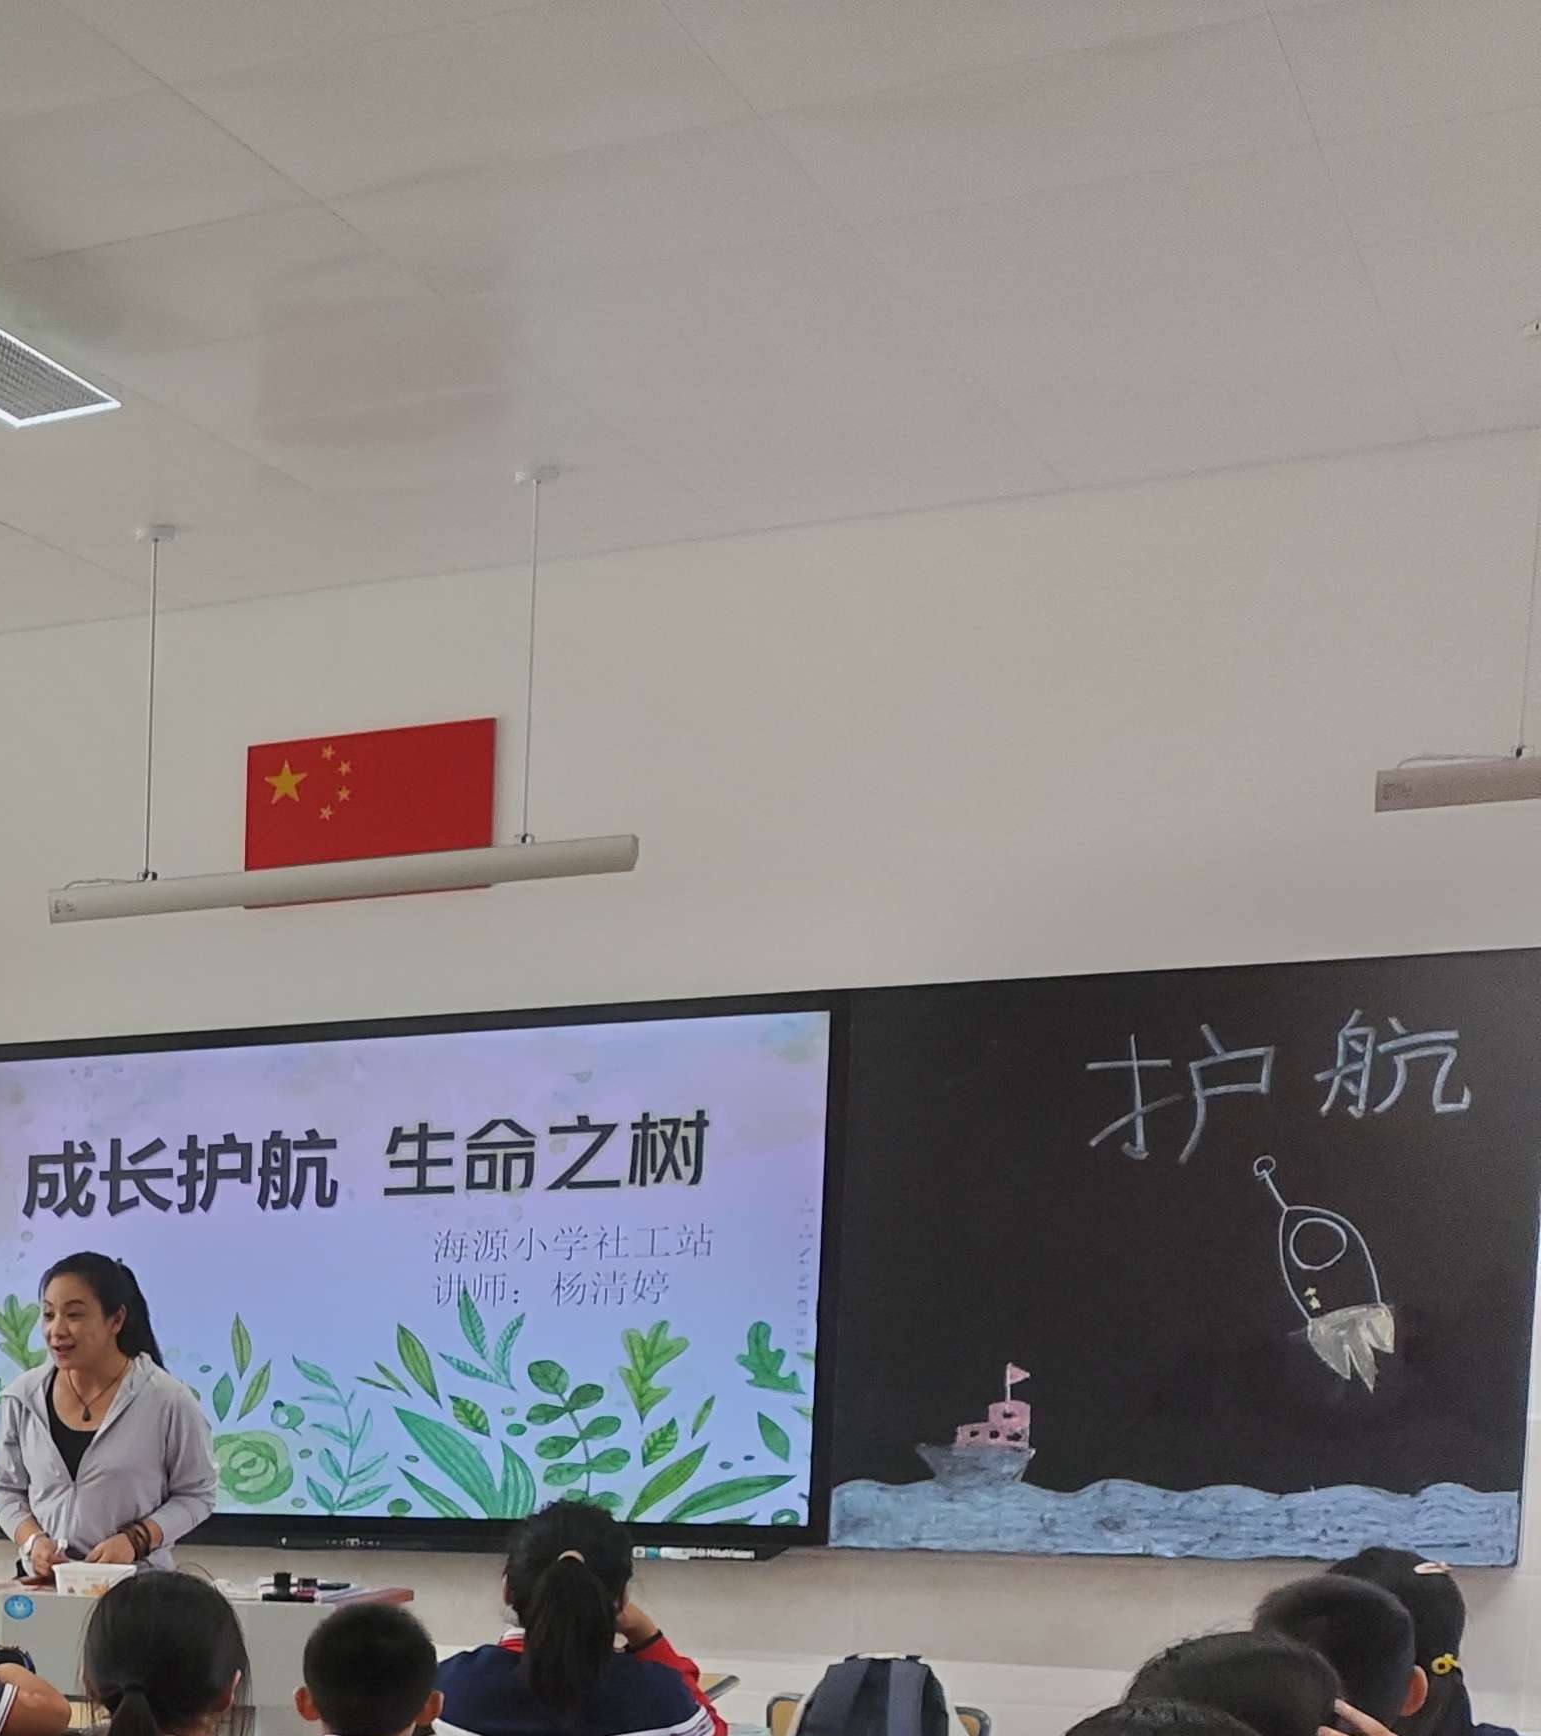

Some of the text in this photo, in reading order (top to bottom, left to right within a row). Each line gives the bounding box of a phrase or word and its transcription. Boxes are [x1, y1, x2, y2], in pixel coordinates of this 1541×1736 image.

[1085, 1008, 1473, 1165] 护航
[22, 1108, 712, 1219] 成长护航 生命之树
[433, 1222, 714, 1264] 海源小学社工站
[551, 1269, 671, 1308] 杨清婷
